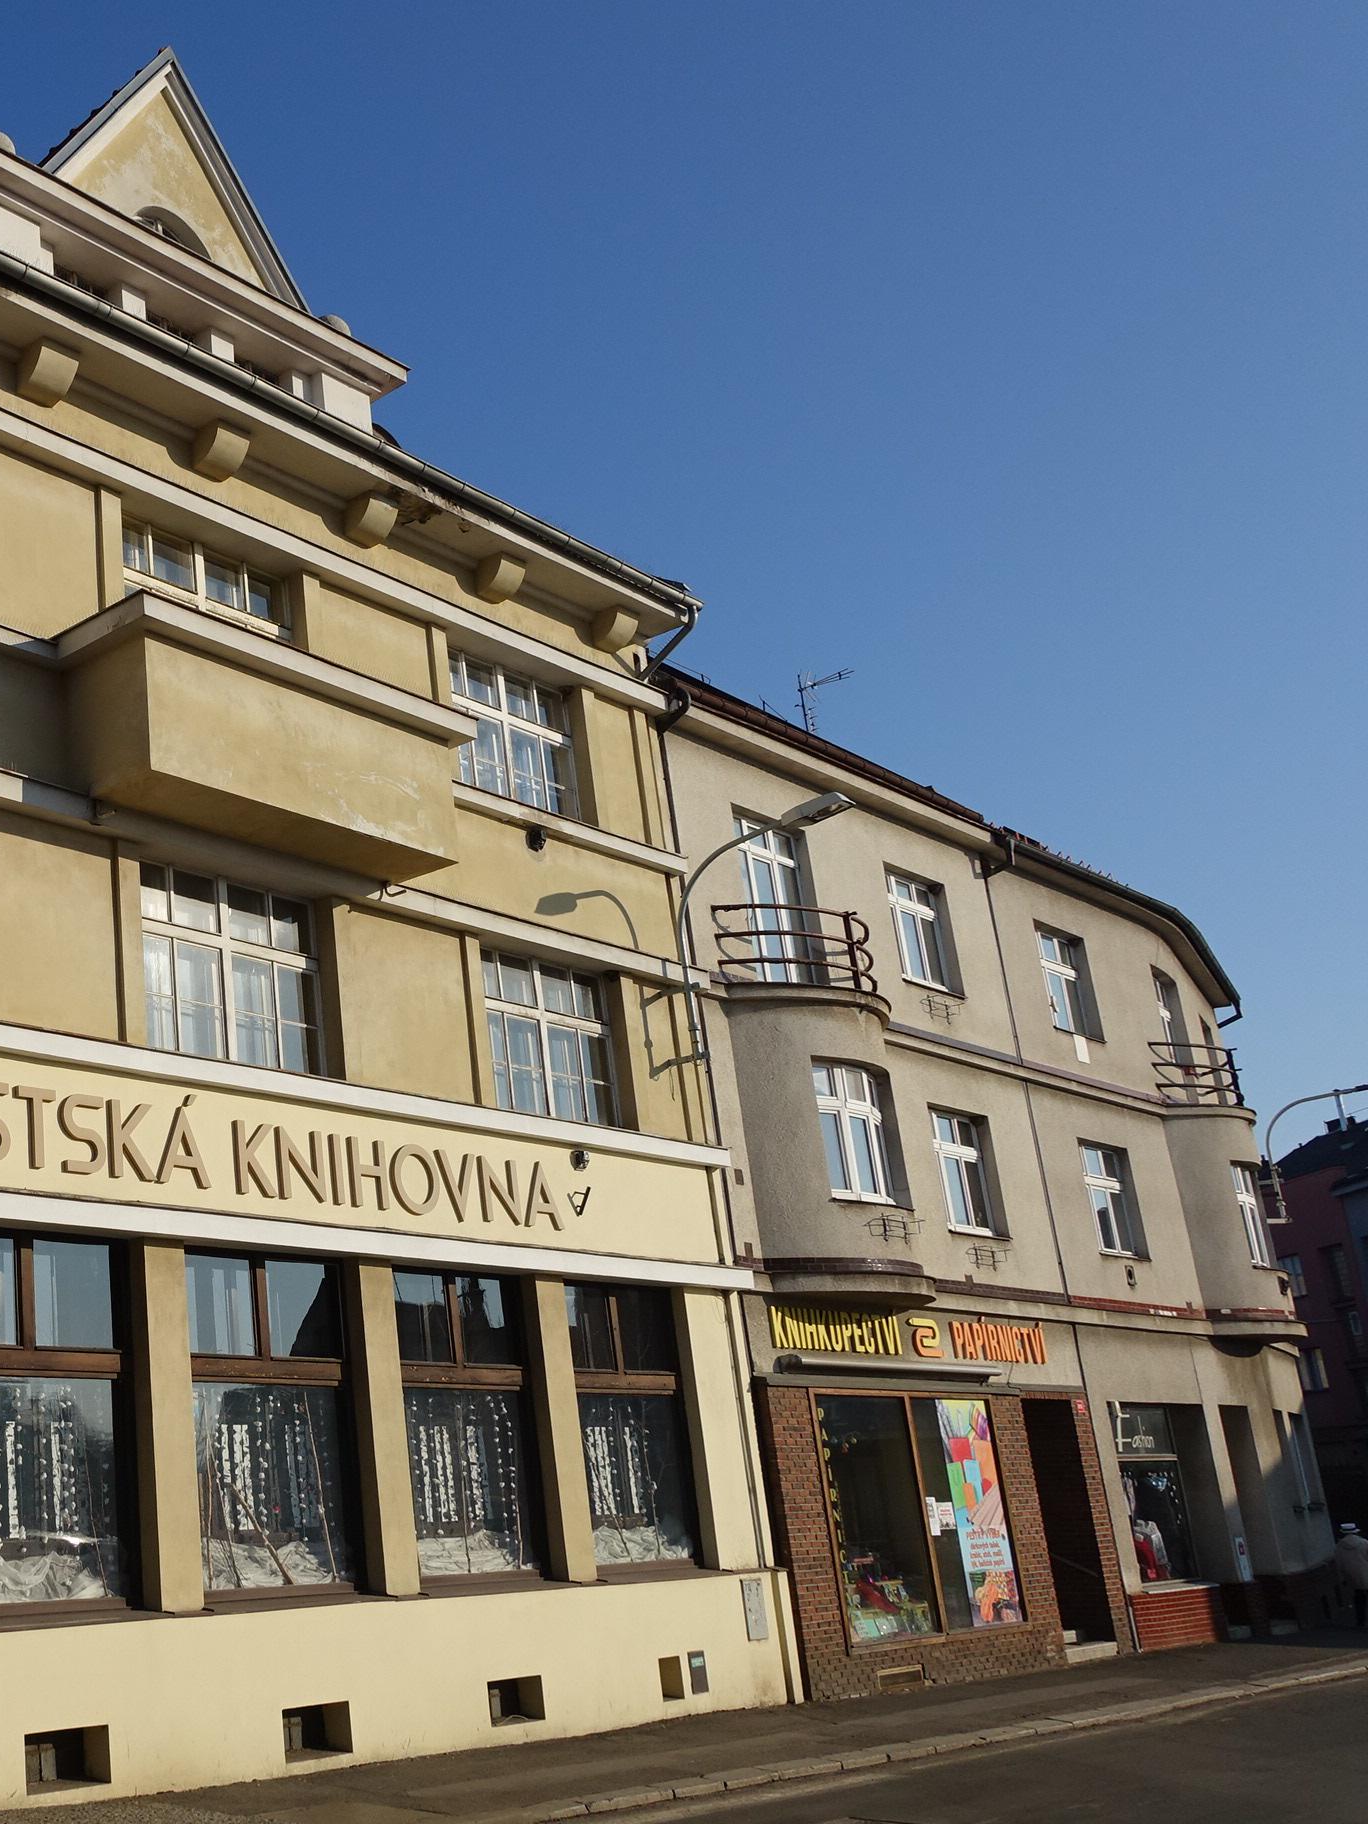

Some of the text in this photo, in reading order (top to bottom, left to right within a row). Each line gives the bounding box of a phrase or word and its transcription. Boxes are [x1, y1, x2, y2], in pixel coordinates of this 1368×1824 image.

[230, 1119, 565, 1232] KNIHOVNA
[767, 1305, 1048, 1364] KNIHKUPECTVÍ PAPÍRNICTVÍ
